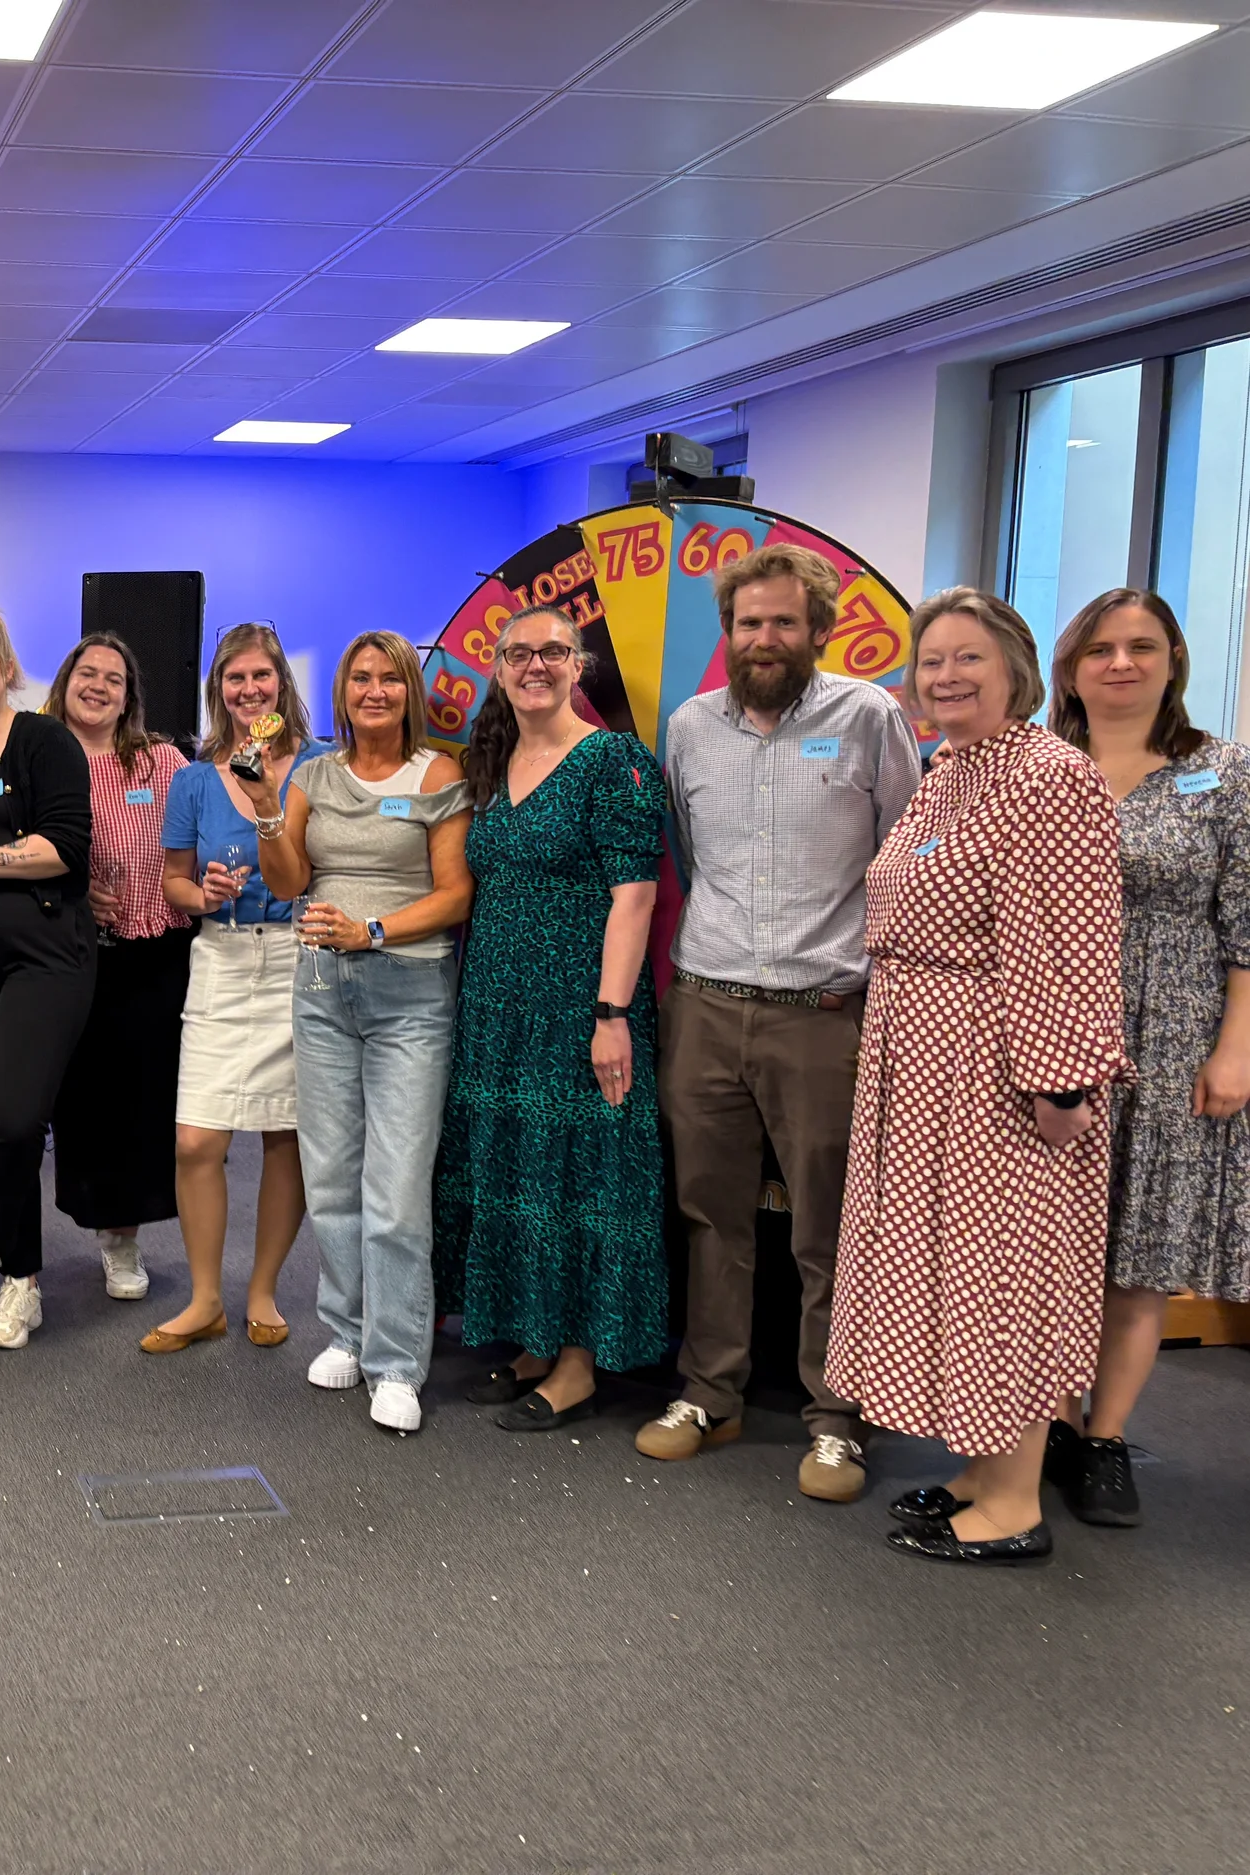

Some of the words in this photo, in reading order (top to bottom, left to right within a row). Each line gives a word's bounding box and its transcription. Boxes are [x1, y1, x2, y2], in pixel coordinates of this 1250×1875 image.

[511, 548, 598, 608] LOSE
[597, 521, 665, 583] 75
[677, 521, 754, 577] 60
[828, 592, 900, 676] 70
[427, 667, 477, 735] 65
